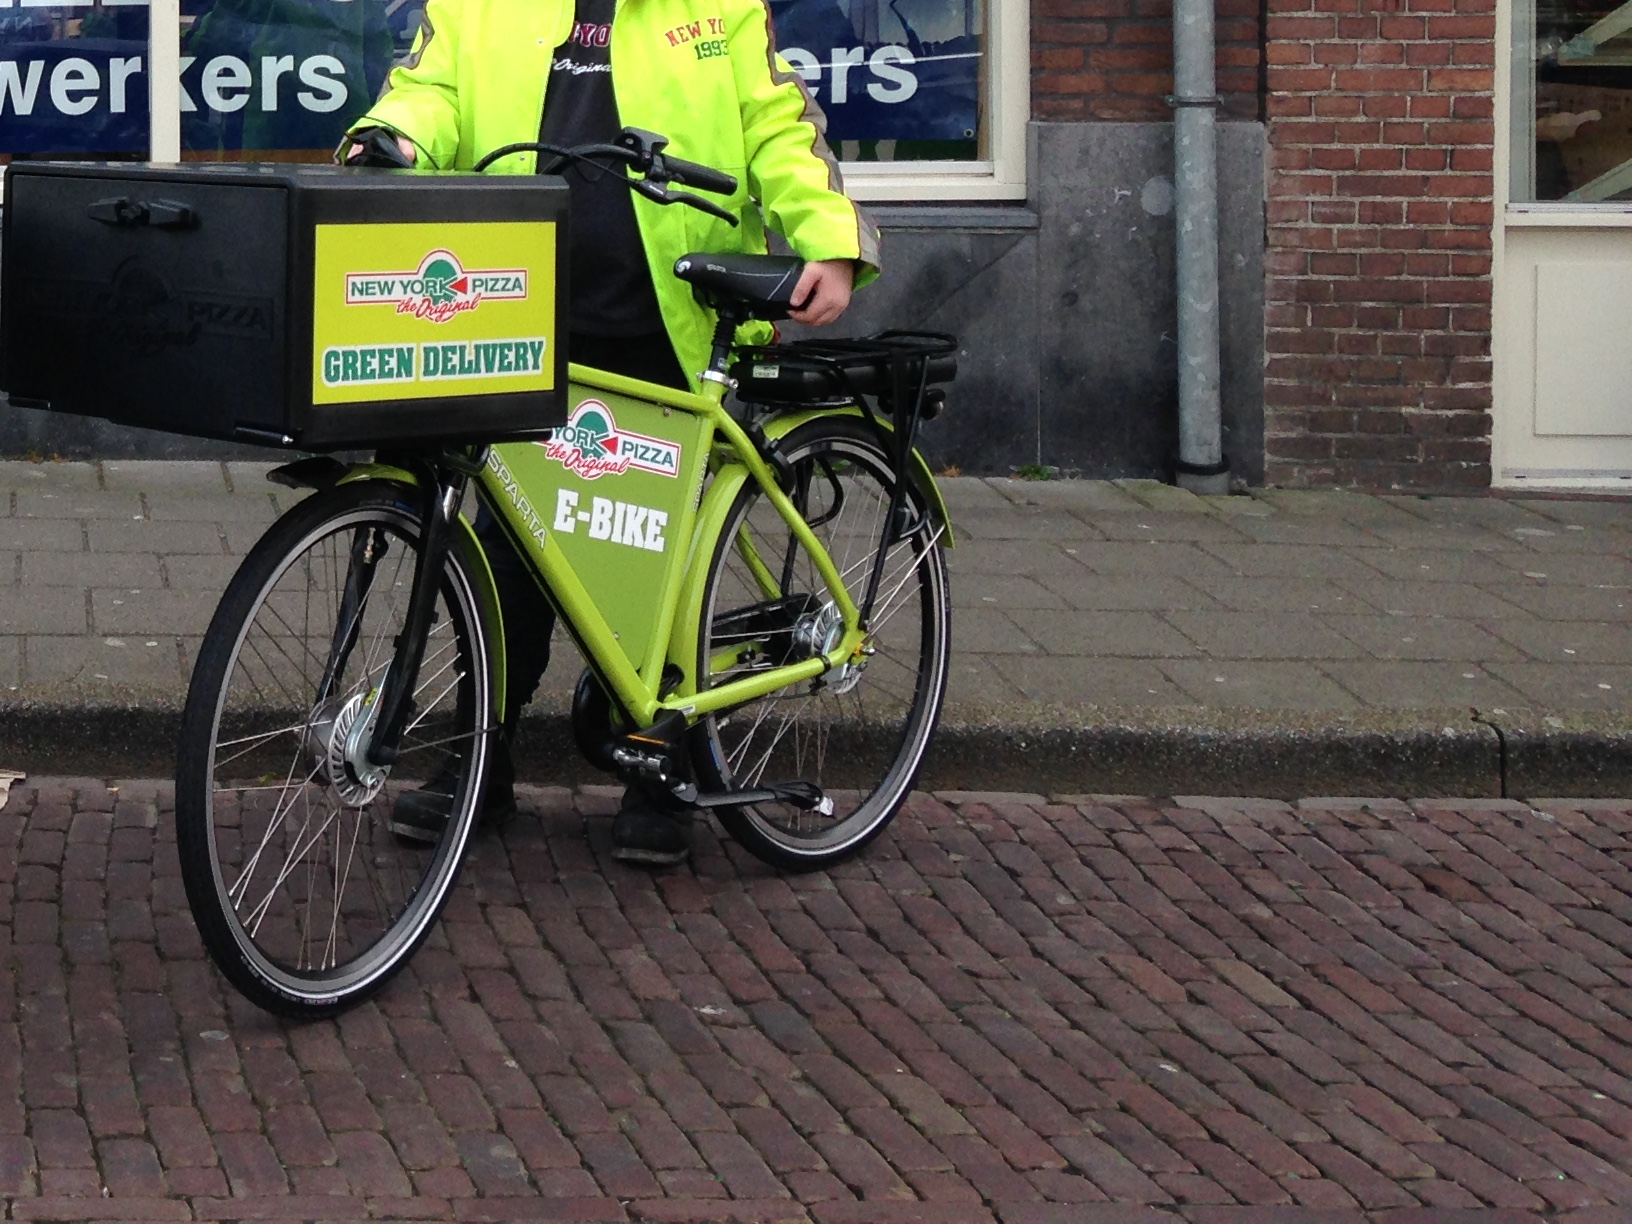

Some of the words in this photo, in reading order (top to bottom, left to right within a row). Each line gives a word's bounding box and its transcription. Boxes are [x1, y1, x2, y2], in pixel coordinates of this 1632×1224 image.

[665, 20, 702, 47] NEW
[694, 39, 730, 61] 1993
[351, 280, 395, 297] NEW
[399, 276, 458, 296] YORK
[472, 277, 523, 293] PIZZA
[397, 299, 417, 314] the
[416, 292, 481, 322] Original
[324, 347, 415, 384] GREEN
[422, 340, 544, 377] DELIVERY
[546, 444, 565, 460] the
[564, 447, 630, 477] Original
[553, 426, 610, 457] YORK
[621, 440, 674, 468] PIZZA
[487, 450, 547, 551] SPARTA
[553, 488, 669, 553] E-BIKE
